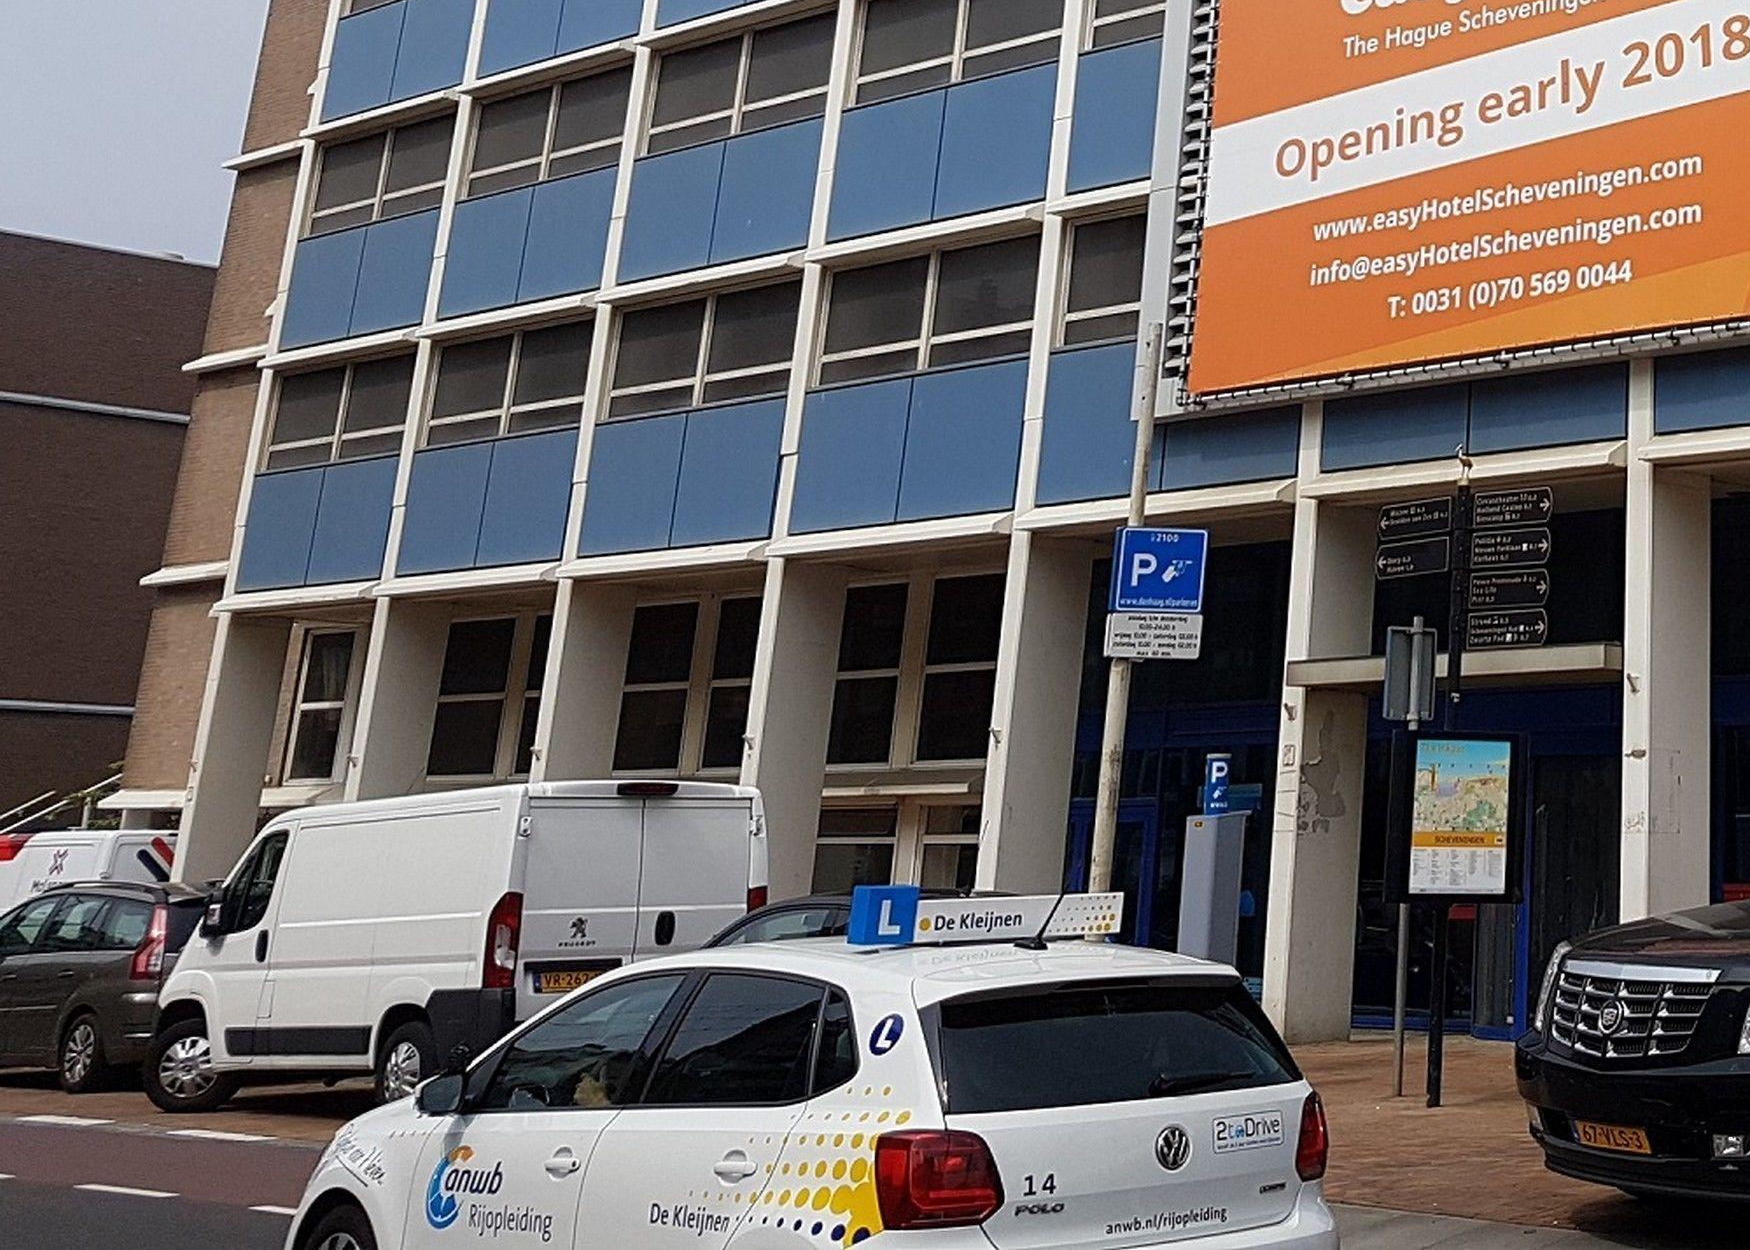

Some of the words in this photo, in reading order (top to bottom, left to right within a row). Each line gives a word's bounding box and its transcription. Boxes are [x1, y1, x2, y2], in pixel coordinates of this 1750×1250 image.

[1343, 35, 1378, 58] The
[1385, 21, 1452, 49] Hague
[1275, 100, 1465, 182] Opening
[1478, 57, 1606, 127] early
[1312, 154, 1703, 242] www.easyHotelScheveningen.com
[1309, 201, 1703, 287] info@easyHotelScheveningen.com
[1388, 296, 1406, 318] T:
[1412, 286, 1462, 315] 0031
[1468, 276, 1524, 310] (0)70
[1530, 269, 1571, 297] 569
[1576, 259, 1632, 290] 0044
[1131, 553, 1157, 587] P
[1211, 761, 1228, 783] P
[878, 899, 900, 936] L
[934, 915, 955, 931] De
[960, 911, 1023, 933] Kleijnen
[875, 1018, 895, 1049] L
[445, 1161, 503, 1194] anwb
[469, 1204, 553, 1242] Rijopleiding
[650, 1203, 669, 1225] De
[672, 1204, 730, 1237] Kleijnen
[1014, 1202, 1065, 1216] POLO
[1105, 1206, 1228, 1236] anwb.nl/rijopleiding
